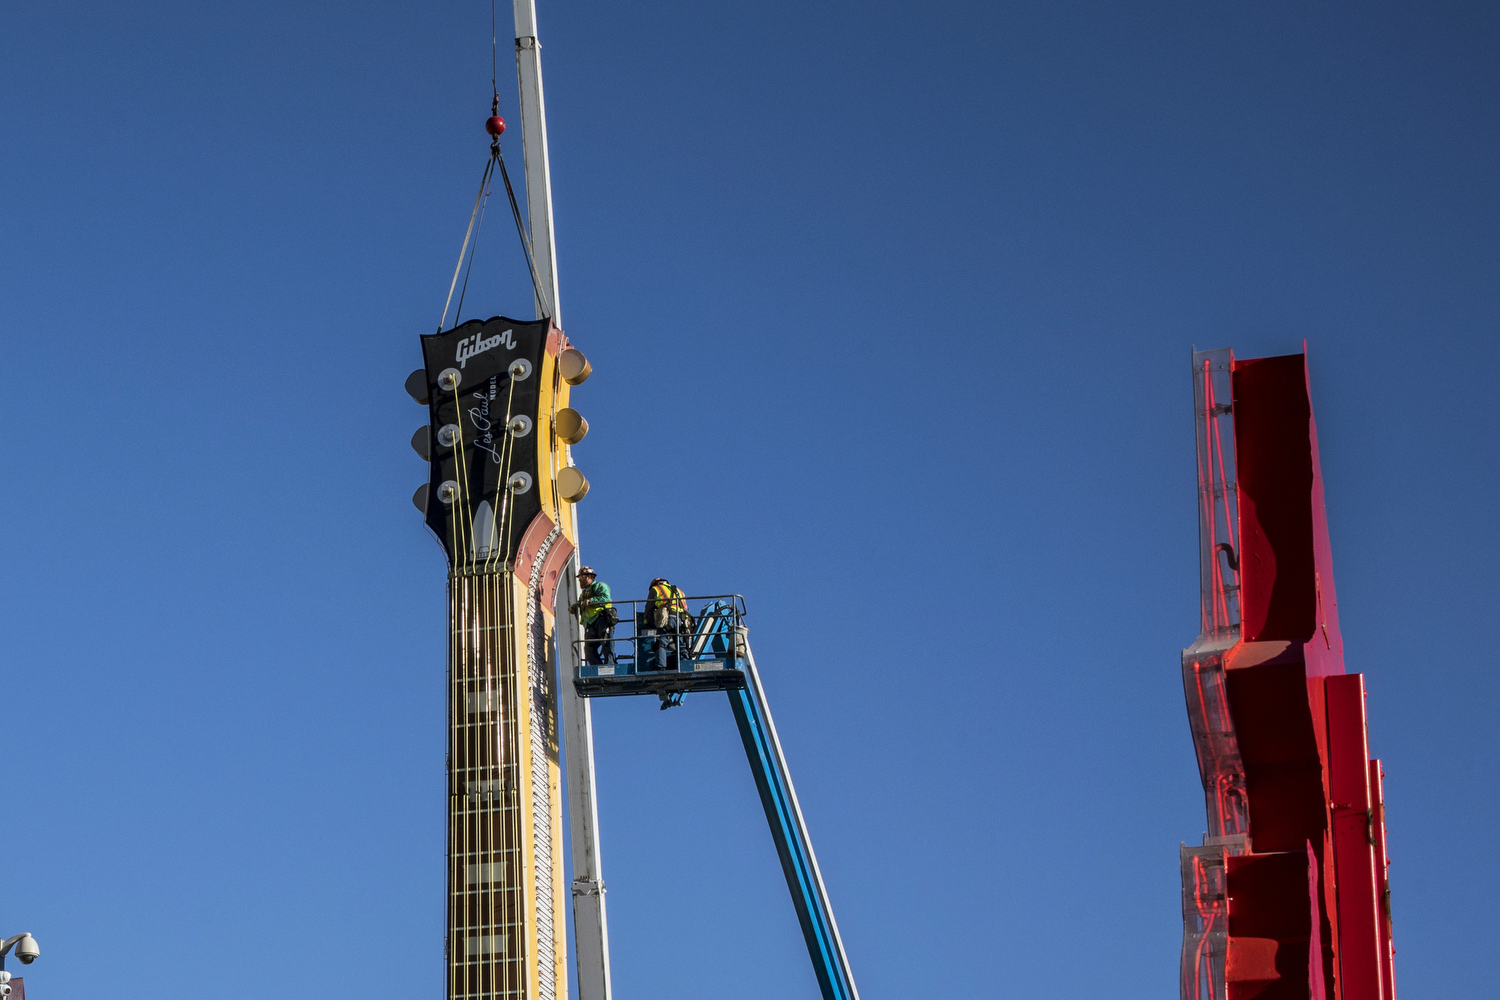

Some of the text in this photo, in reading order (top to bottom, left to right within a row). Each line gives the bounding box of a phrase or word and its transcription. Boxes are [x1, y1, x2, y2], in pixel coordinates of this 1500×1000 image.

[455, 329, 517, 369] Gibson
[489, 375, 497, 401] MODEL
[467, 392, 501, 464] Les Paul
